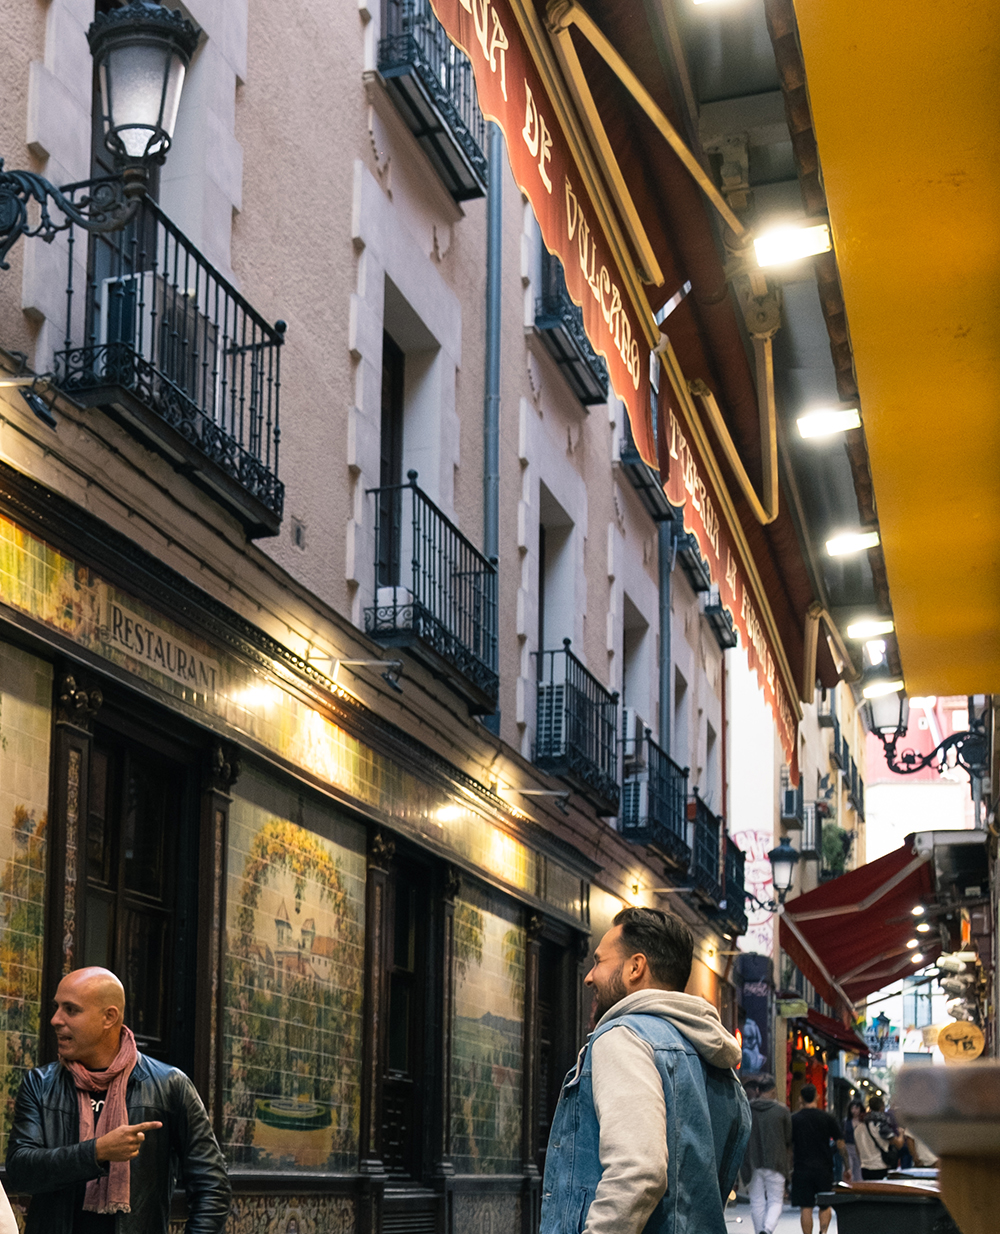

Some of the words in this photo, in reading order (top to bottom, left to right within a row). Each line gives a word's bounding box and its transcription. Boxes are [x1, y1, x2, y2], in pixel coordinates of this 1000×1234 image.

[459, 0, 509, 103] UA
[521, 76, 554, 195] DE
[564, 173, 641, 391] VULCANO
[668, 406, 720, 561] TABERNA
[725, 546, 738, 602] LA
[111, 605, 218, 692] RESTAURANT
